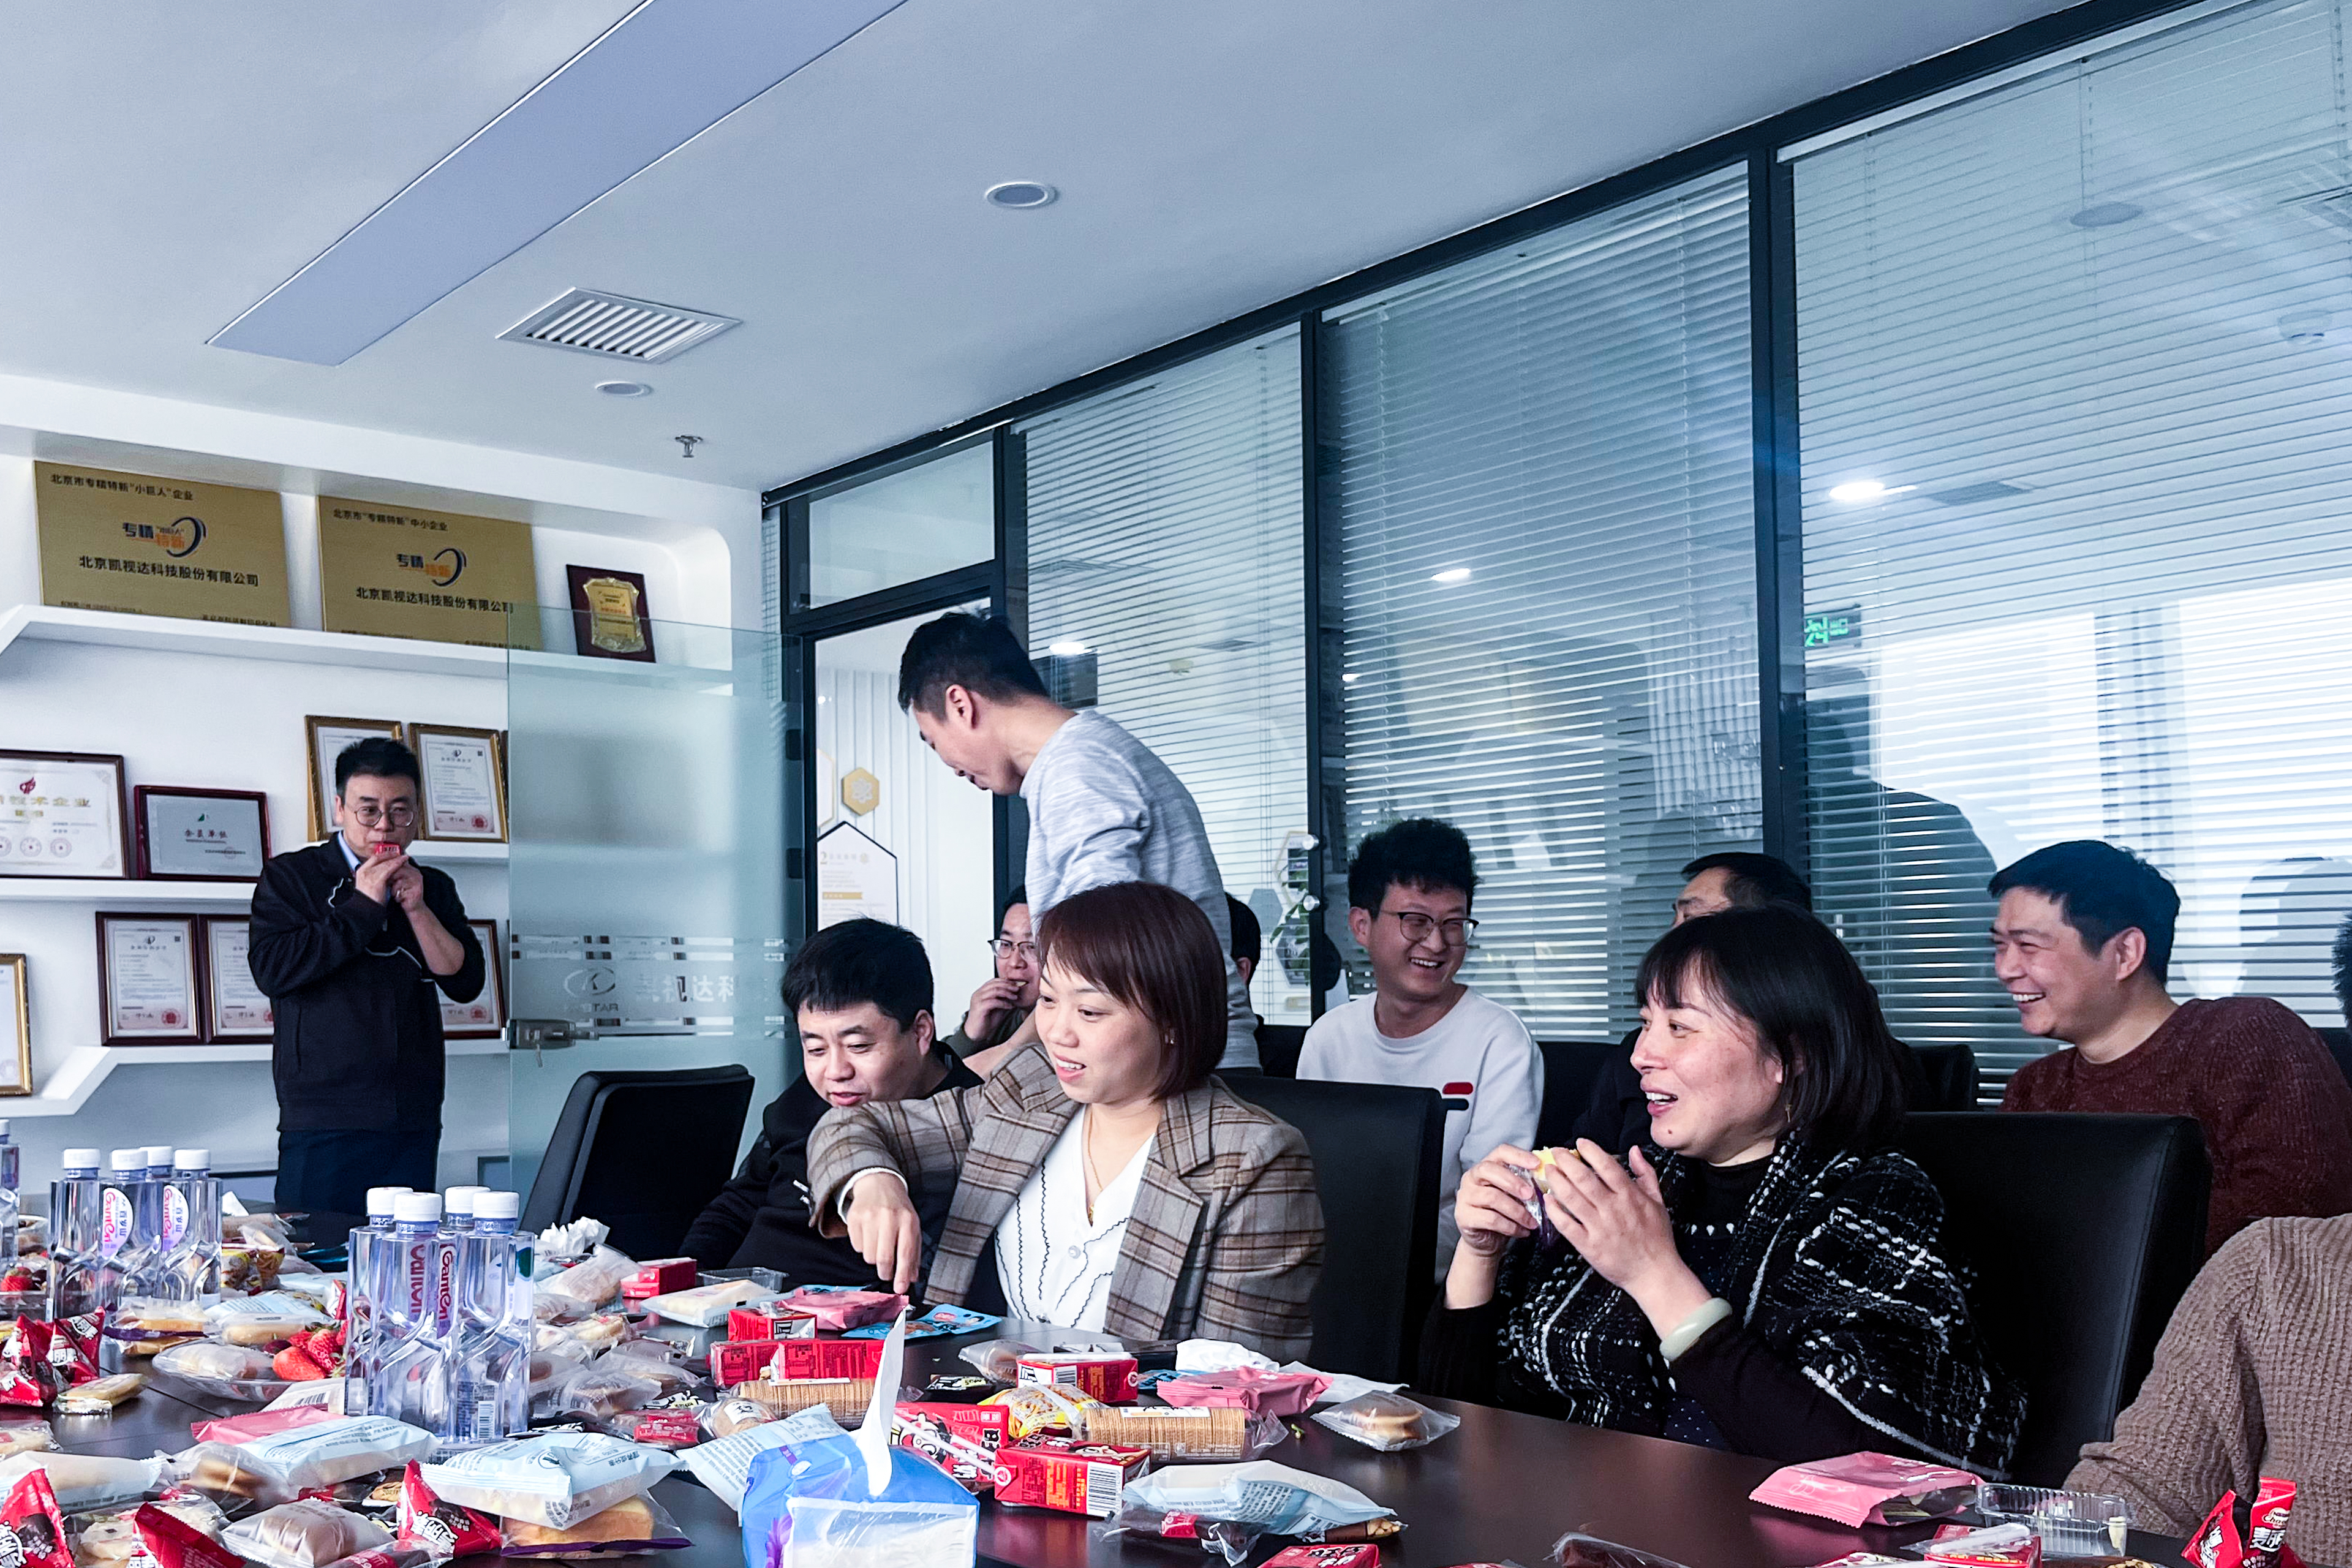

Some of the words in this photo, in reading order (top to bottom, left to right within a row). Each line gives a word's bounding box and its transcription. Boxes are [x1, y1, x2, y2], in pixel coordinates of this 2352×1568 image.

[79, 555, 258, 587] 北京凯视达科技股份有限公司
[356, 586, 513, 614] 北京凯视达科技股份有限公司
